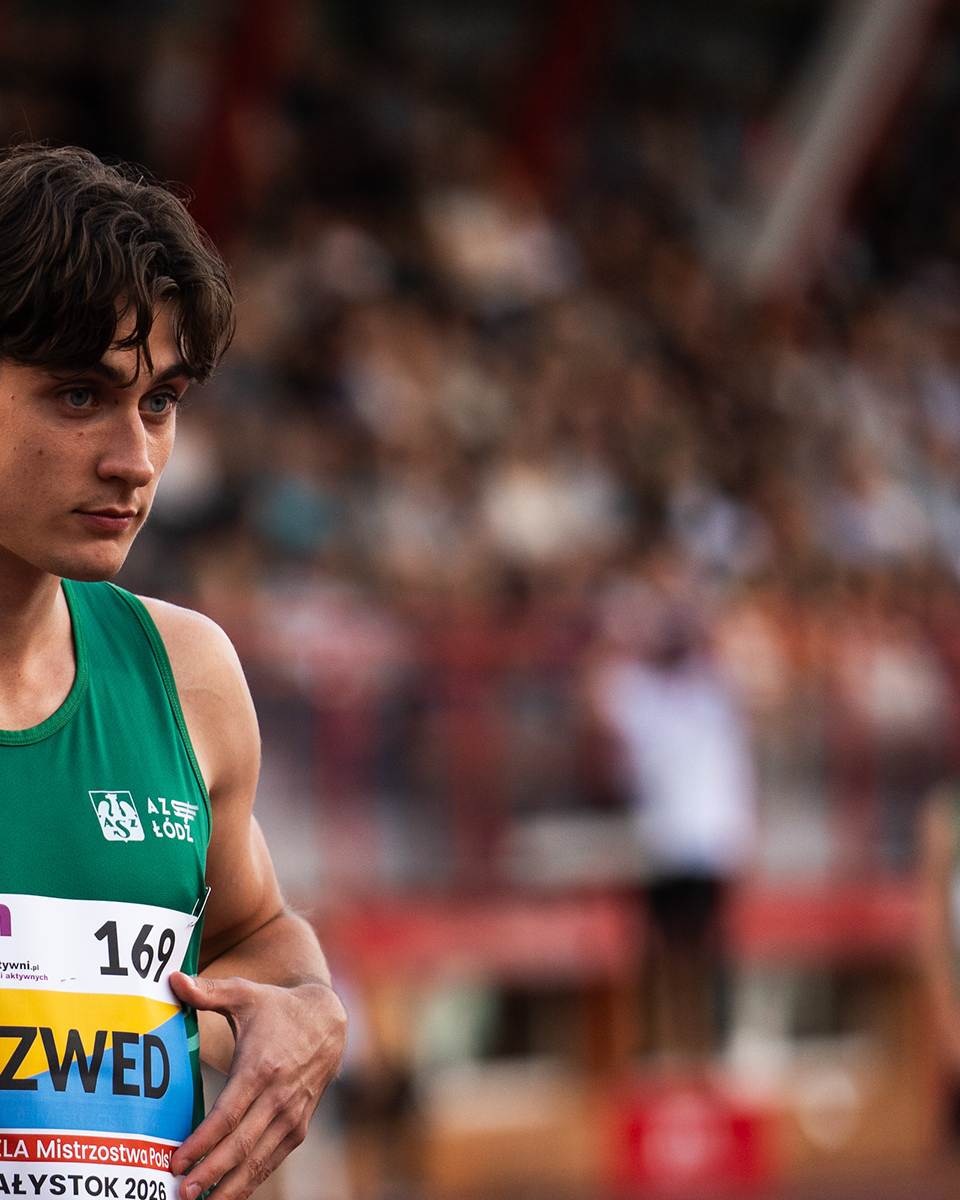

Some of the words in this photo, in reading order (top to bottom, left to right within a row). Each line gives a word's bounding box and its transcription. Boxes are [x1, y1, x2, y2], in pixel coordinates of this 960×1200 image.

[93, 920, 176, 983] 169
[5, 972, 49, 982] aktywnych
[36, 1138, 148, 1165] Mistrzostwa
